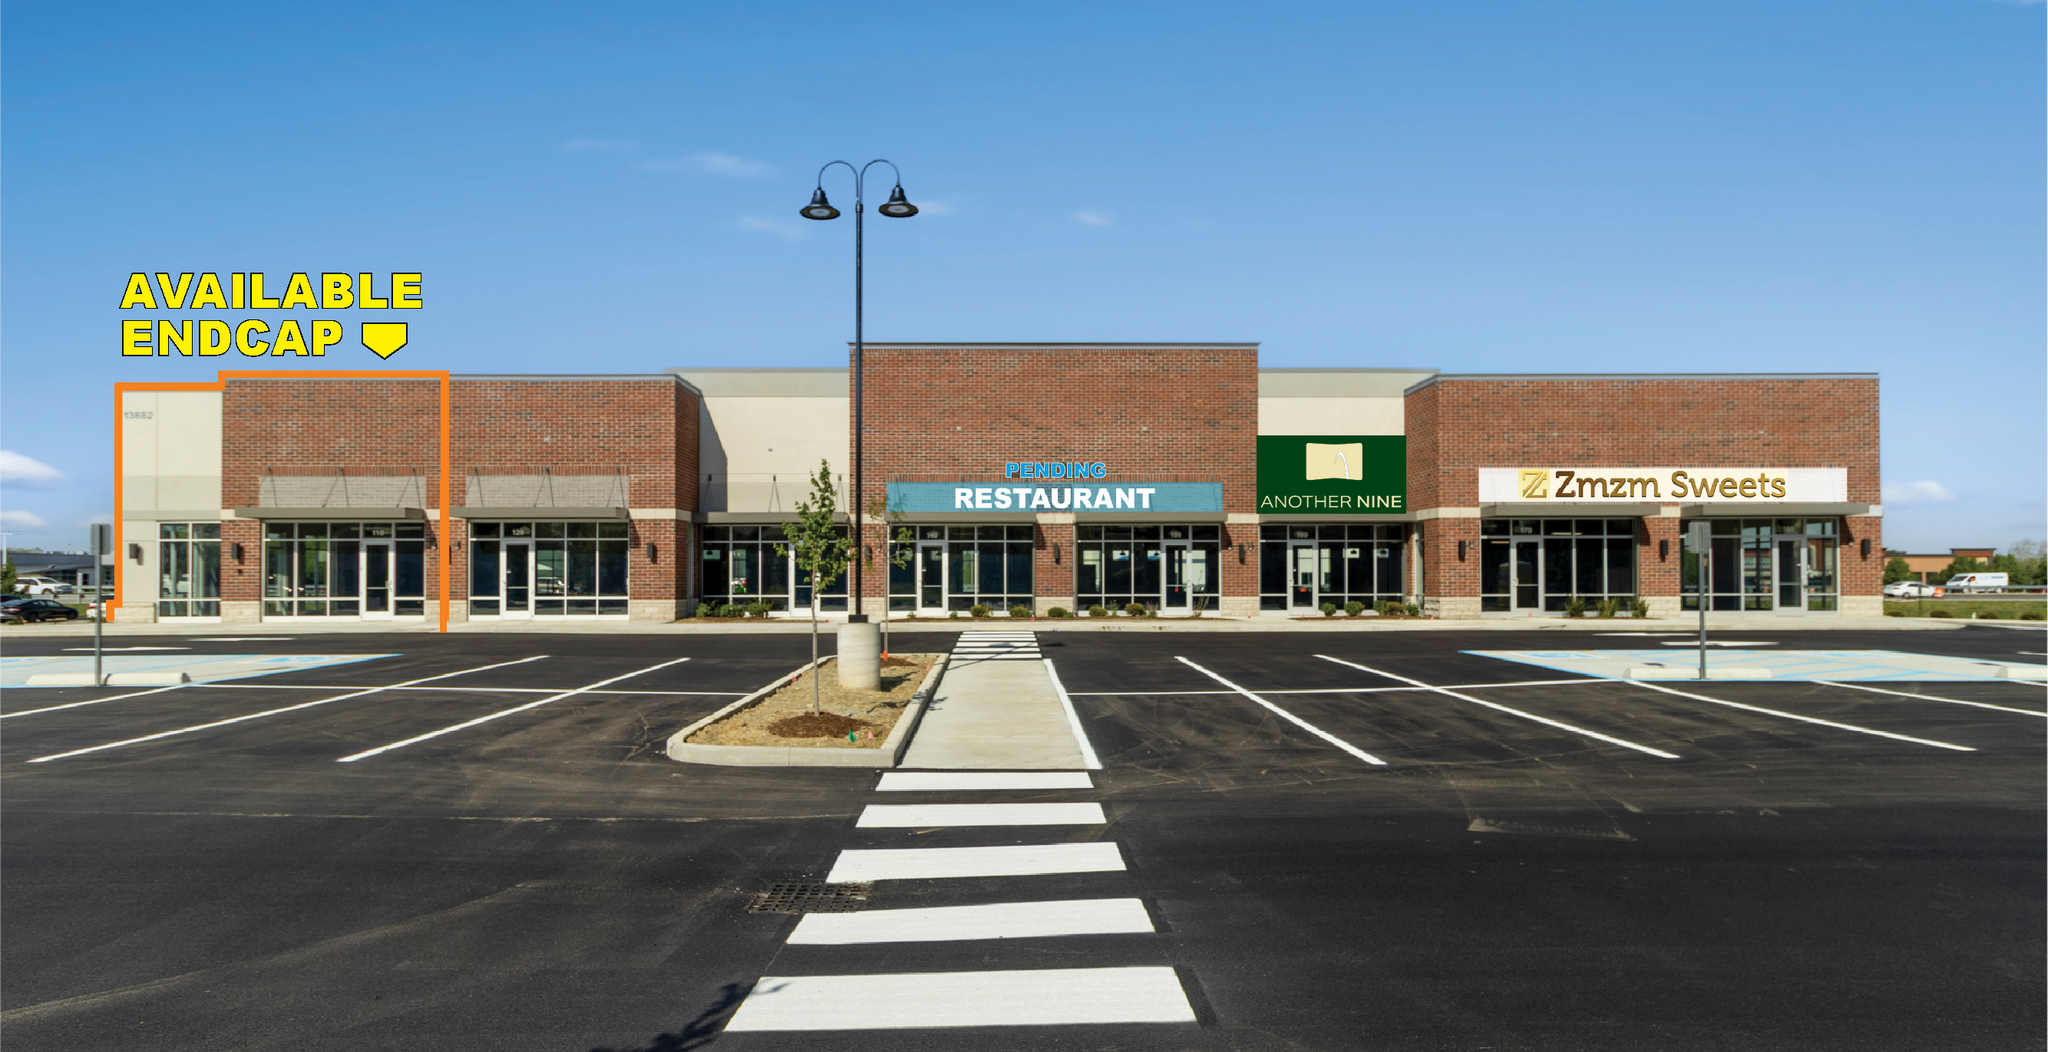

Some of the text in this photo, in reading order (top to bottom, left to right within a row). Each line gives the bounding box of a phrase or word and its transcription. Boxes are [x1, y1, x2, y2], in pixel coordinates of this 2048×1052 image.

[1555, 470, 1661, 498] Zmzm
[1671, 470, 1786, 498] Sweets
[1260, 495, 1402, 508] ANOTHER NINE
